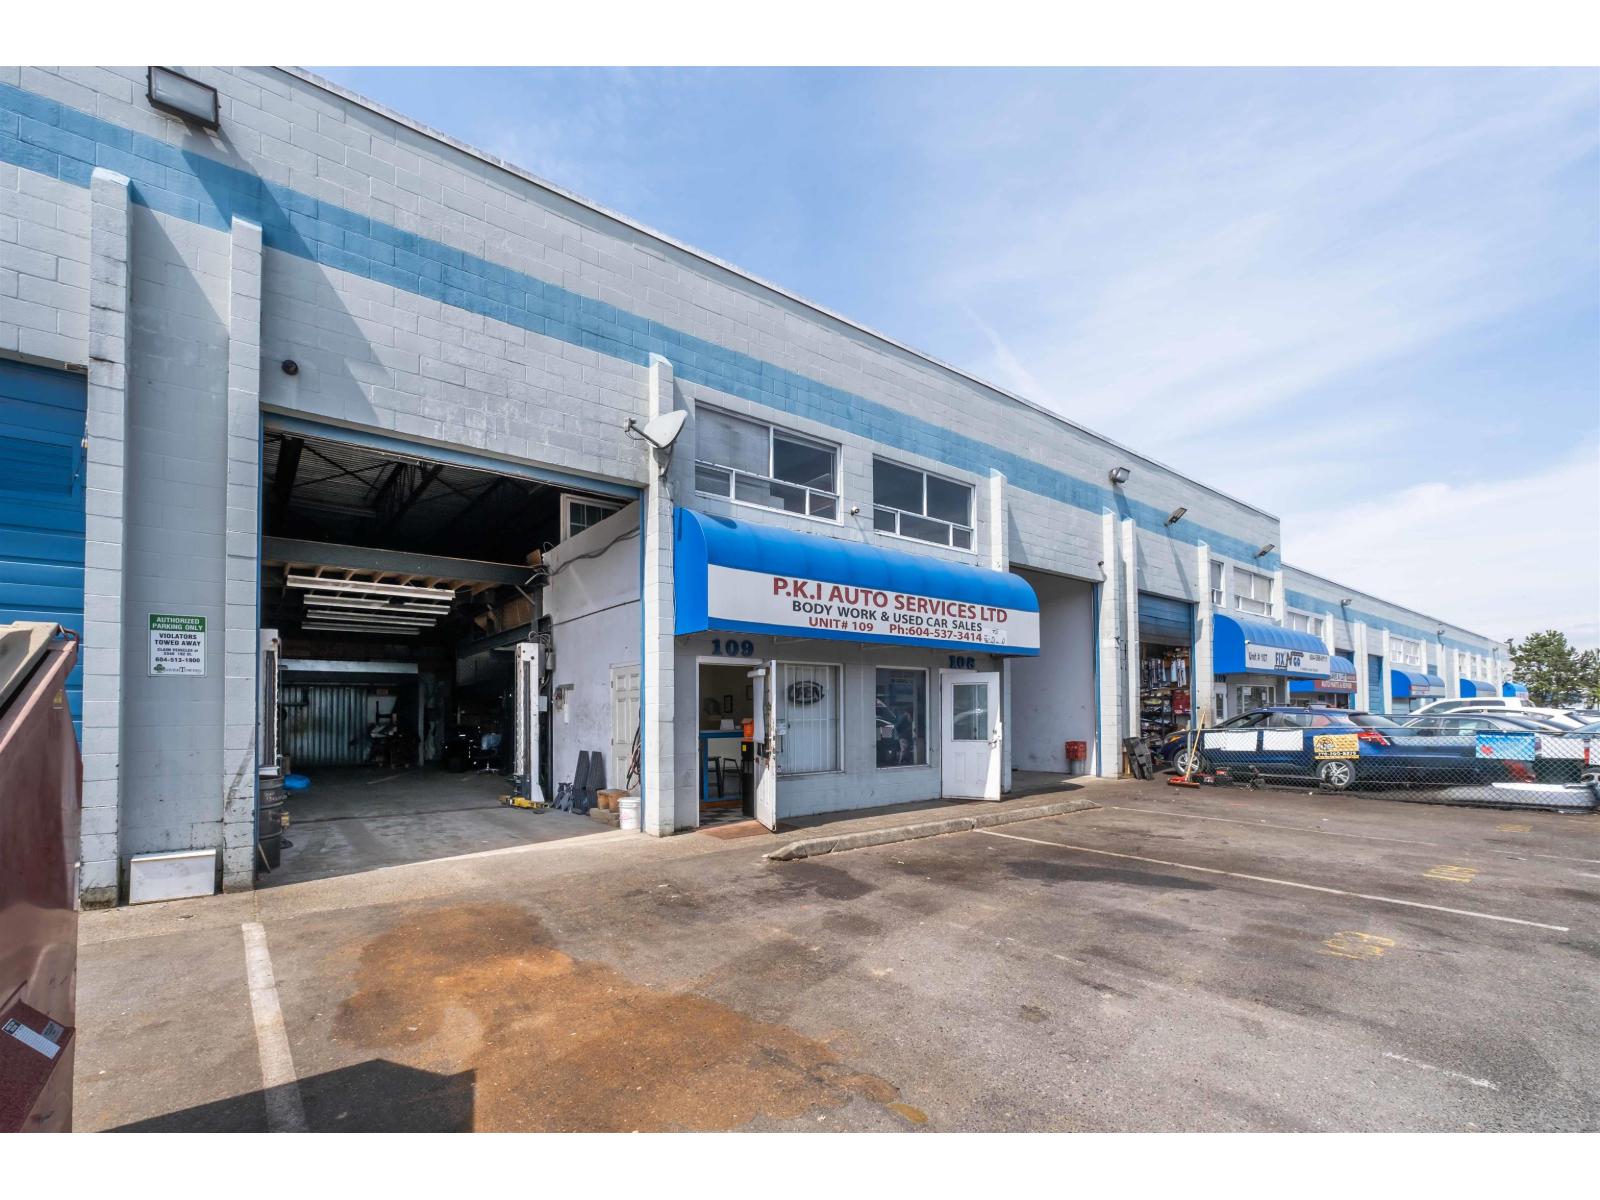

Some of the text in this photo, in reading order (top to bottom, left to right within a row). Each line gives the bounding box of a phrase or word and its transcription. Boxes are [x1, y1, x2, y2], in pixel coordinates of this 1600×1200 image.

[773, 577, 1008, 623] P.K.I AUTO SERVICES LTD
[792, 600, 983, 632] BODY WORK & USED CAR SALES
[808, 616, 849, 630] UNIT#
[852, 621, 874, 632] 109
[889, 623, 983, 643] Ph:604-537-3414
[711, 638, 754, 657] 109
[1275, 652, 1285, 667] FIX
